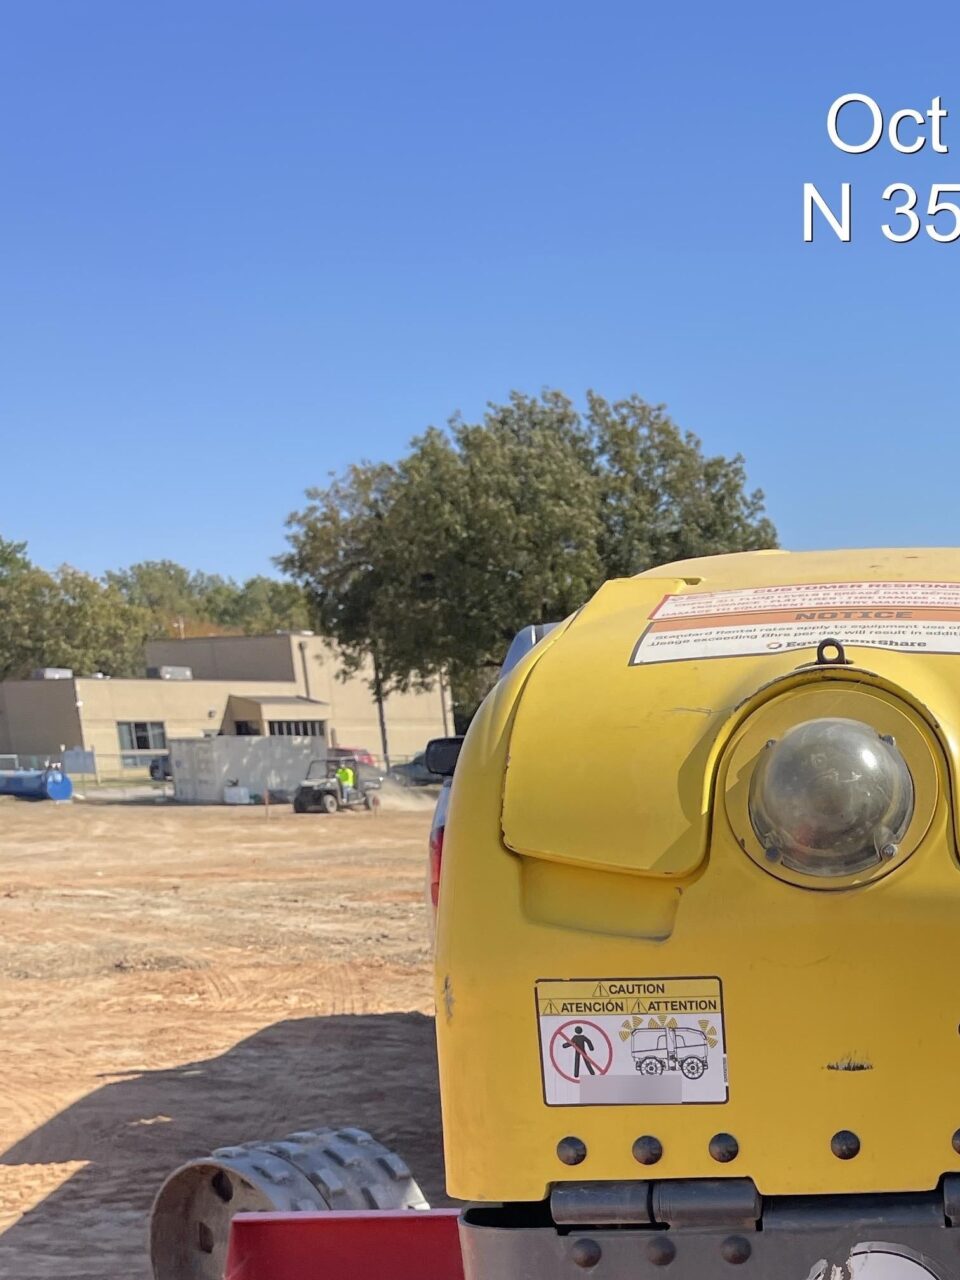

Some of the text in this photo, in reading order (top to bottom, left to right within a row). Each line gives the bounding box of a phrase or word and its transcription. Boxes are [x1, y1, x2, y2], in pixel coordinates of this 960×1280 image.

[753, 584, 863, 593] CUSTOMER
[794, 611, 914, 621] NOTICE
[654, 632, 713, 640] Standard
[796, 624, 831, 632] apply
[693, 634, 758, 643] exceeding
[785, 639, 927, 648] EquimentShare
[608, 983, 665, 995] CAUTION
[560, 998, 718, 1013] ATENCIÓN ATTENTION
